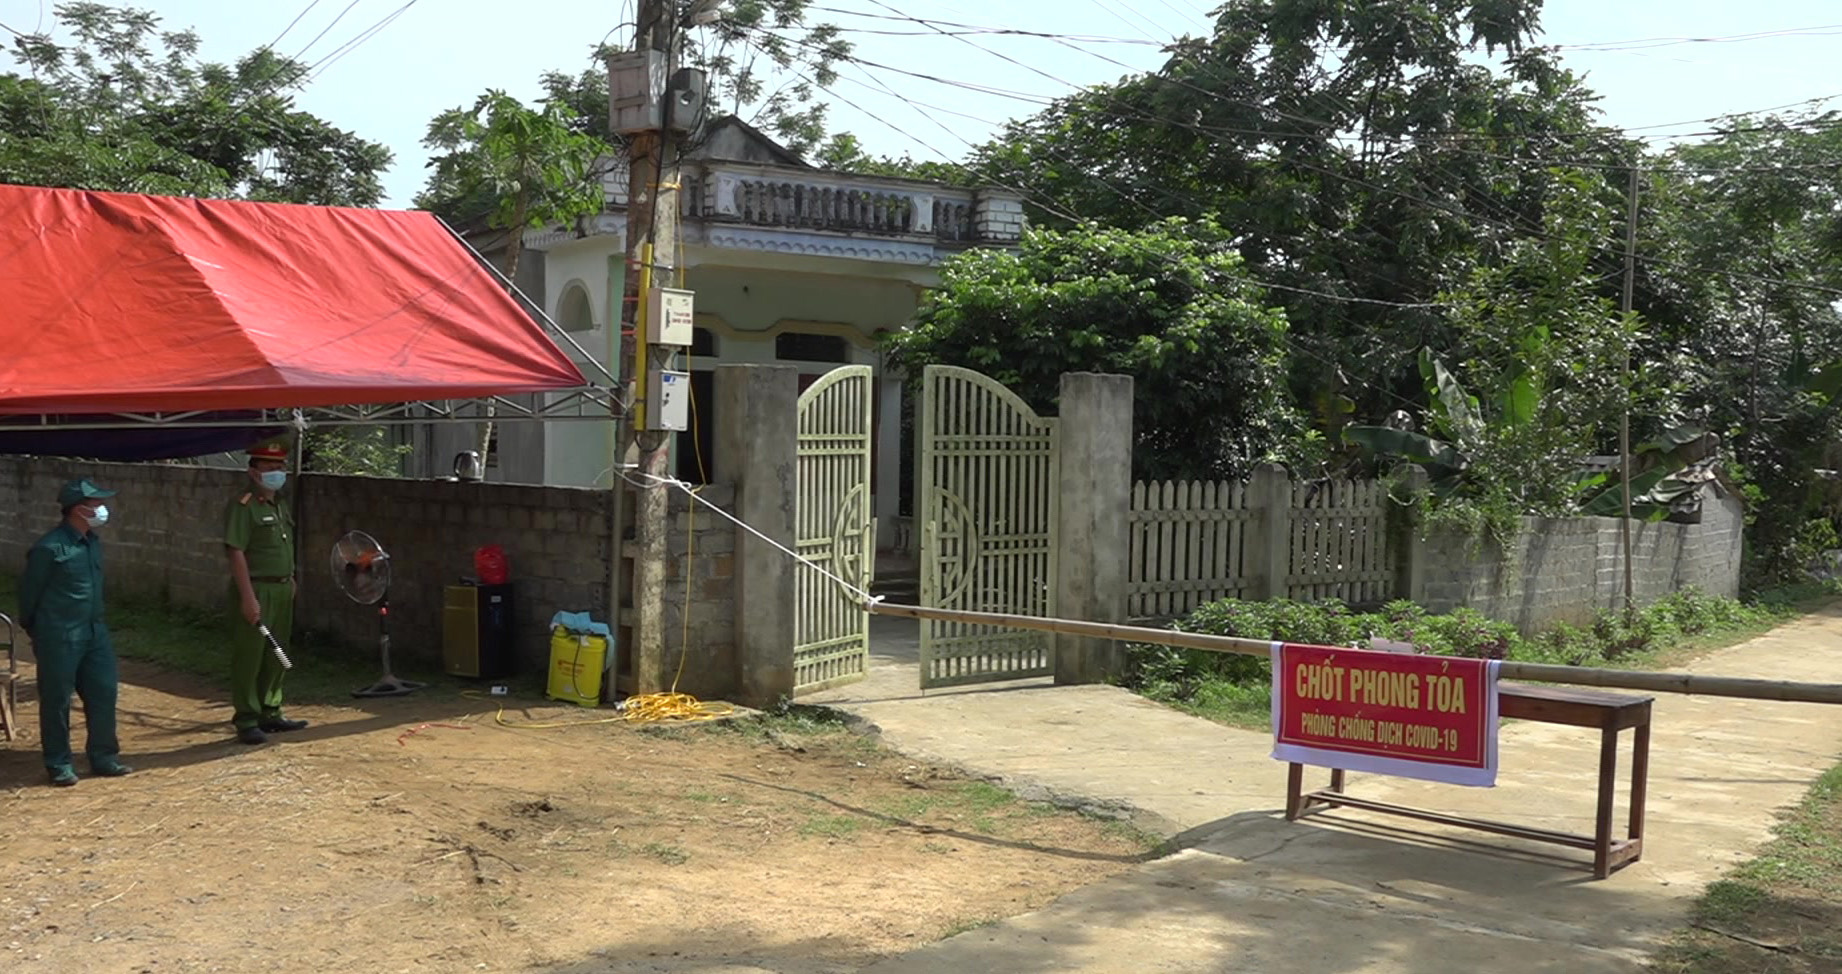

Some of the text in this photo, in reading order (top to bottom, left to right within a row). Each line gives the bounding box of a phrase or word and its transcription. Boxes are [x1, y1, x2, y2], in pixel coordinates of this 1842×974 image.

[1297, 654, 1466, 714] CHỐT PHONG TỎA
[1302, 708, 1458, 752] PHÒNG CHỐNG DỊCH COVID-19
